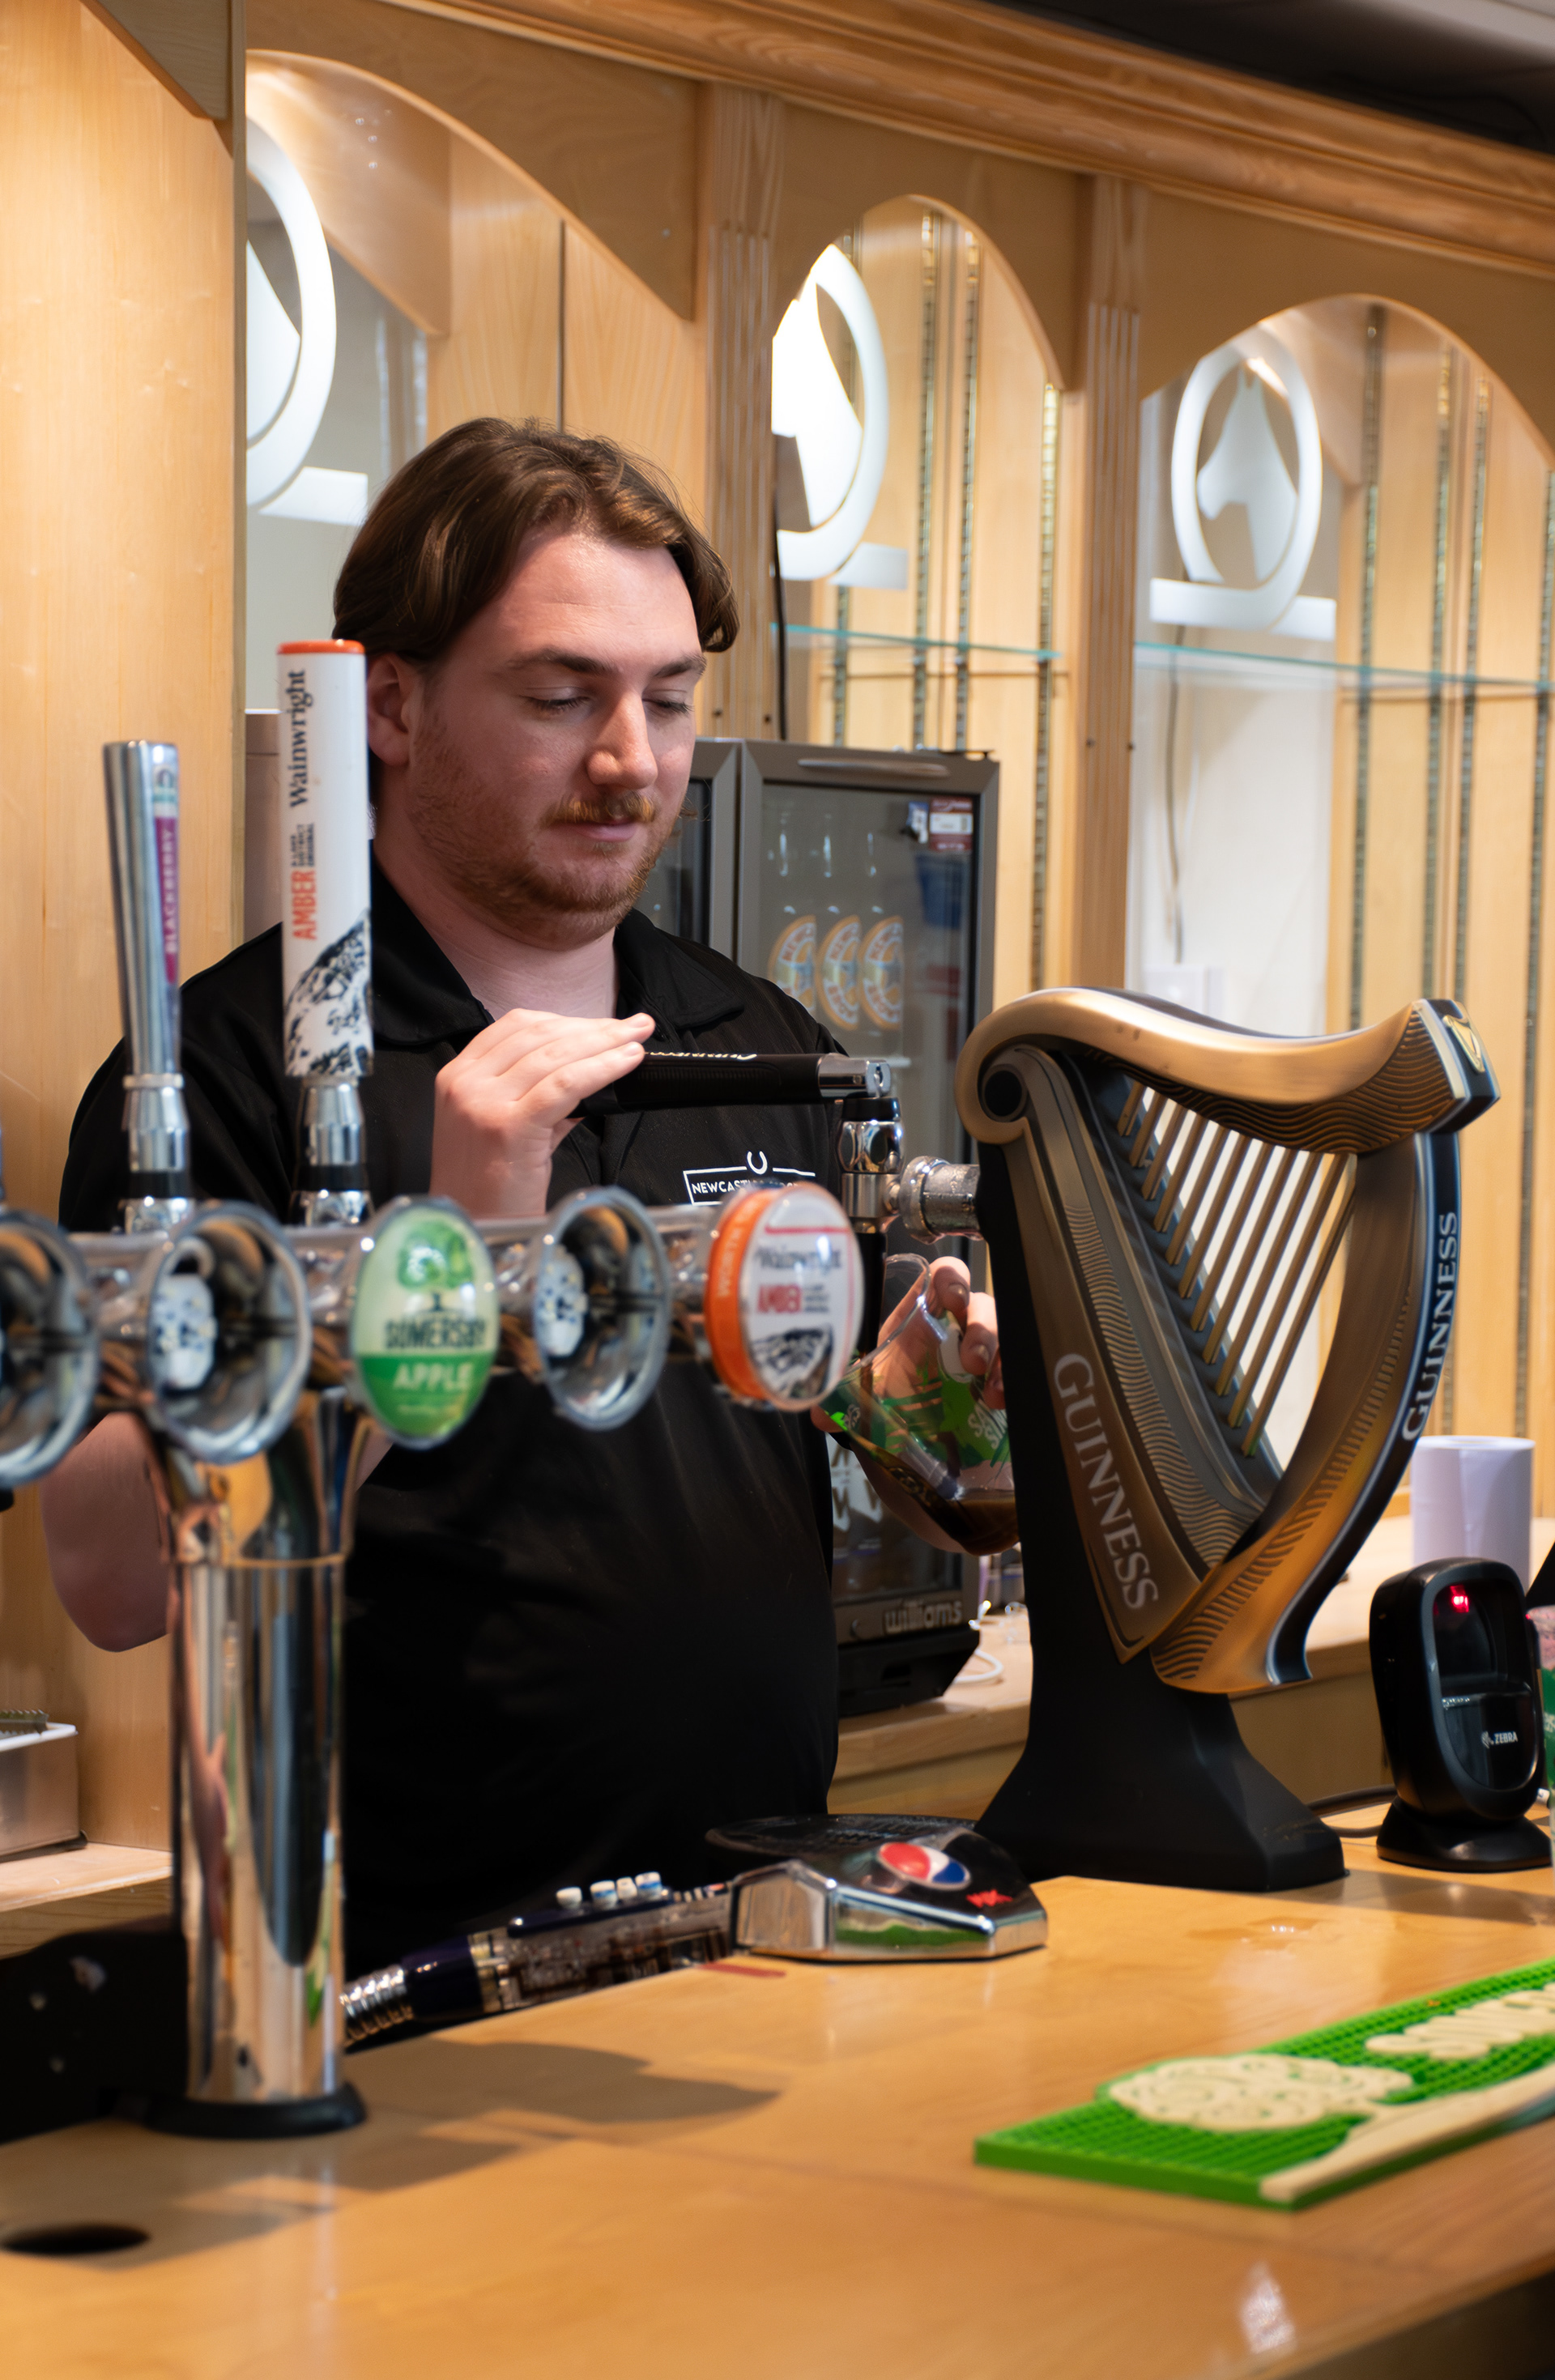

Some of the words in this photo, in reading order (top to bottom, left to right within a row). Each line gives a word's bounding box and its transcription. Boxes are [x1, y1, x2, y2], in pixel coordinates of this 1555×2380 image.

[285, 669, 313, 809] Wainwright
[161, 828, 177, 955] BLACKBERRY
[289, 871, 317, 941] AMBER
[384, 1318, 487, 1350] SOMERSBY
[1400, 1211, 1459, 1441] GUINNESS
[394, 1362, 472, 1391] APPLE
[1053, 1353, 1159, 1611] GUINNESS
[884, 1599, 962, 1633] williams
[1493, 1731, 1519, 1745] ZEBRA
